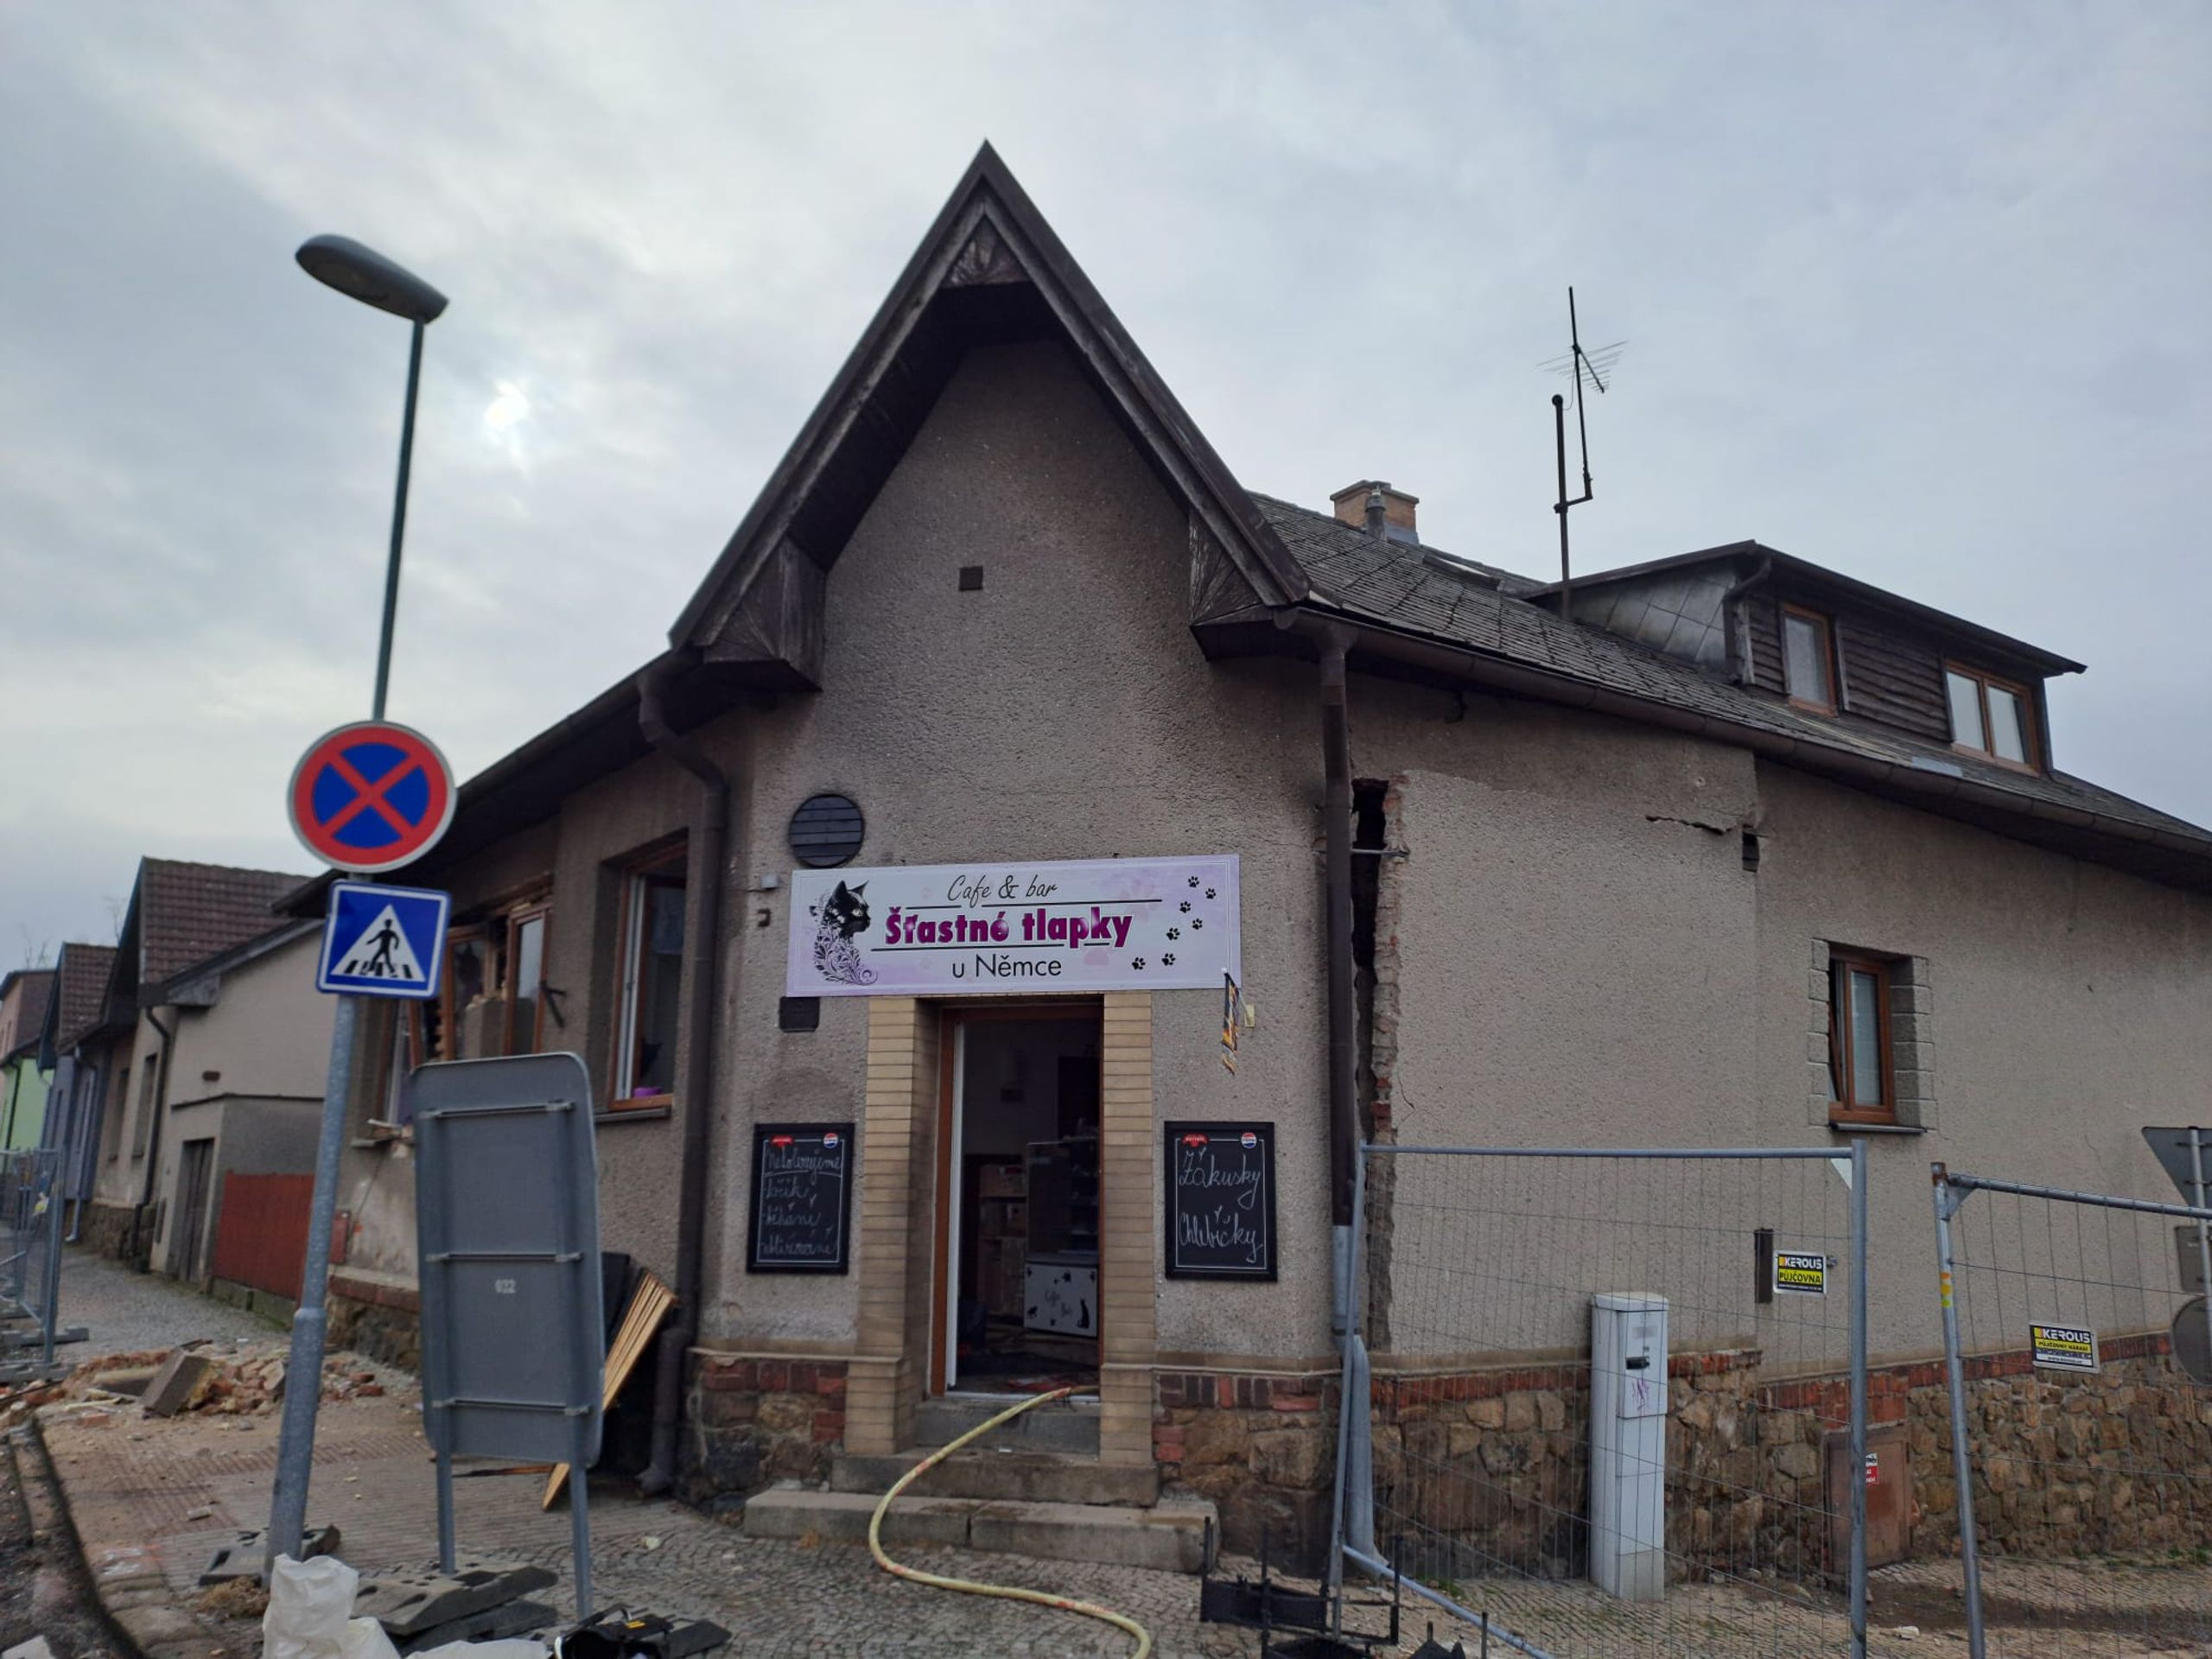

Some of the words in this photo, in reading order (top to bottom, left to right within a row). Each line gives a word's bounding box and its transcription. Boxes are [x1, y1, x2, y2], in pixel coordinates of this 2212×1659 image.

[947, 874, 991, 908] Cafe
[998, 874, 1019, 899] &
[1026, 874, 1058, 897] bar
[885, 906, 1010, 944] Šťastné
[1021, 906, 1133, 949] tlapky
[952, 963, 964, 978] u
[976, 953, 1062, 978] Němce
[1785, 1257, 1822, 1269] KEROUS
[2043, 1328, 2090, 1344] KEROUS
